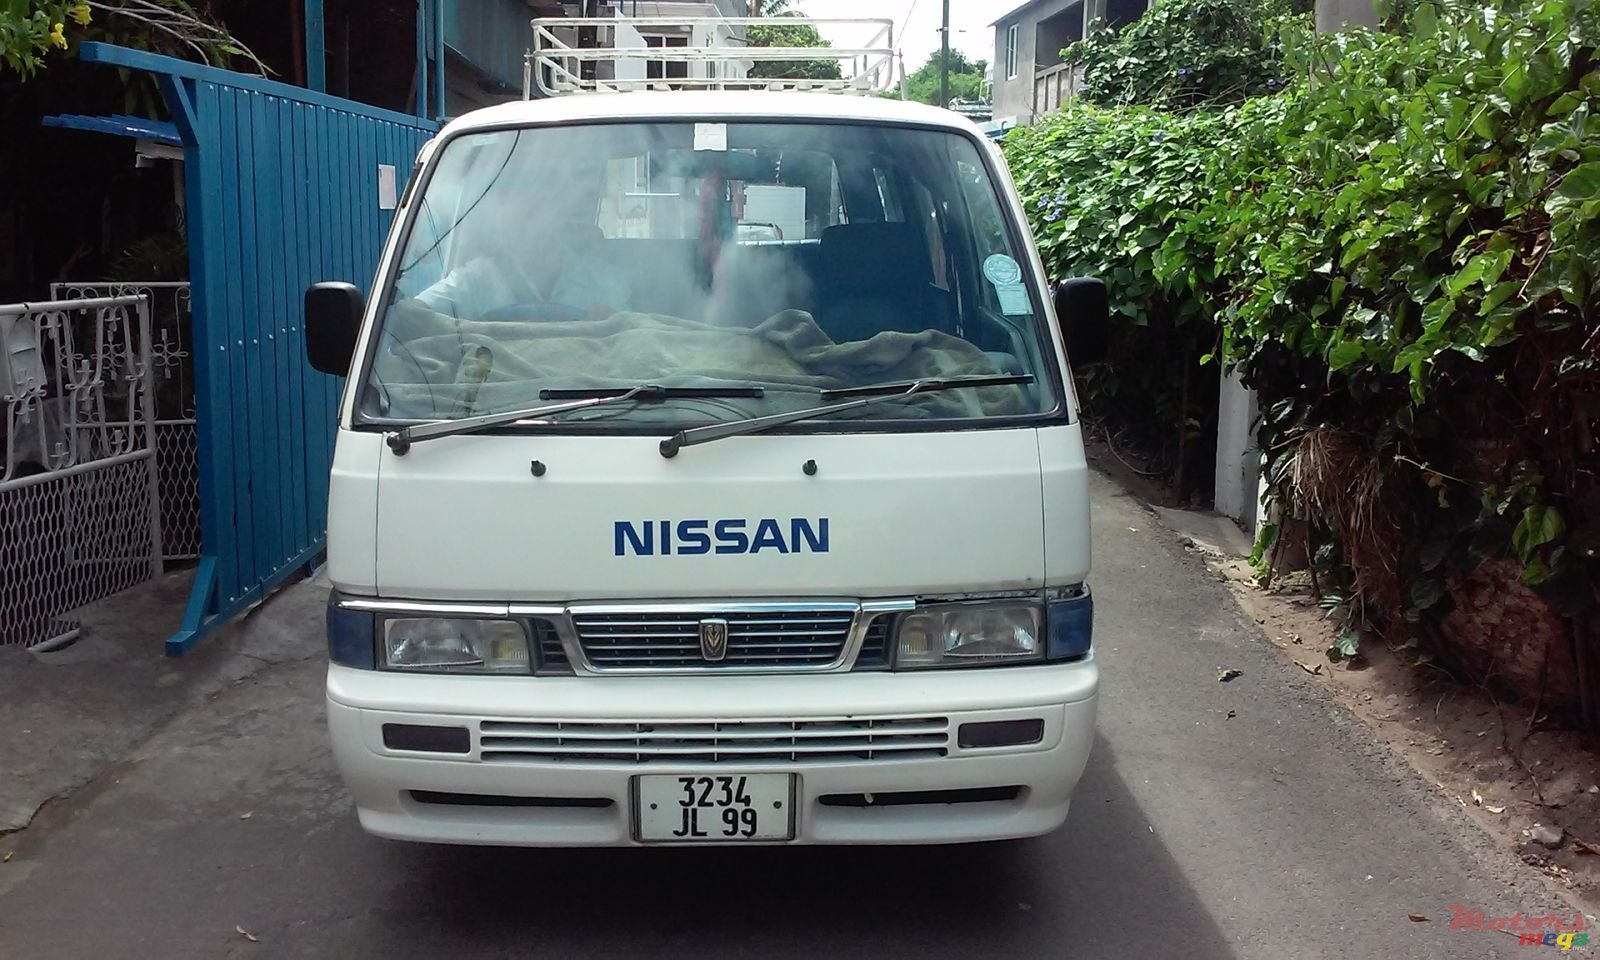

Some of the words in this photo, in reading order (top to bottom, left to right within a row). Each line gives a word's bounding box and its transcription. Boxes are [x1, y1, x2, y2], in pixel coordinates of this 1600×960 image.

[614, 518, 829, 556] NISSAN
[678, 776, 751, 807] 3234
[673, 808, 707, 837] JL
[722, 808, 757, 837] 99
